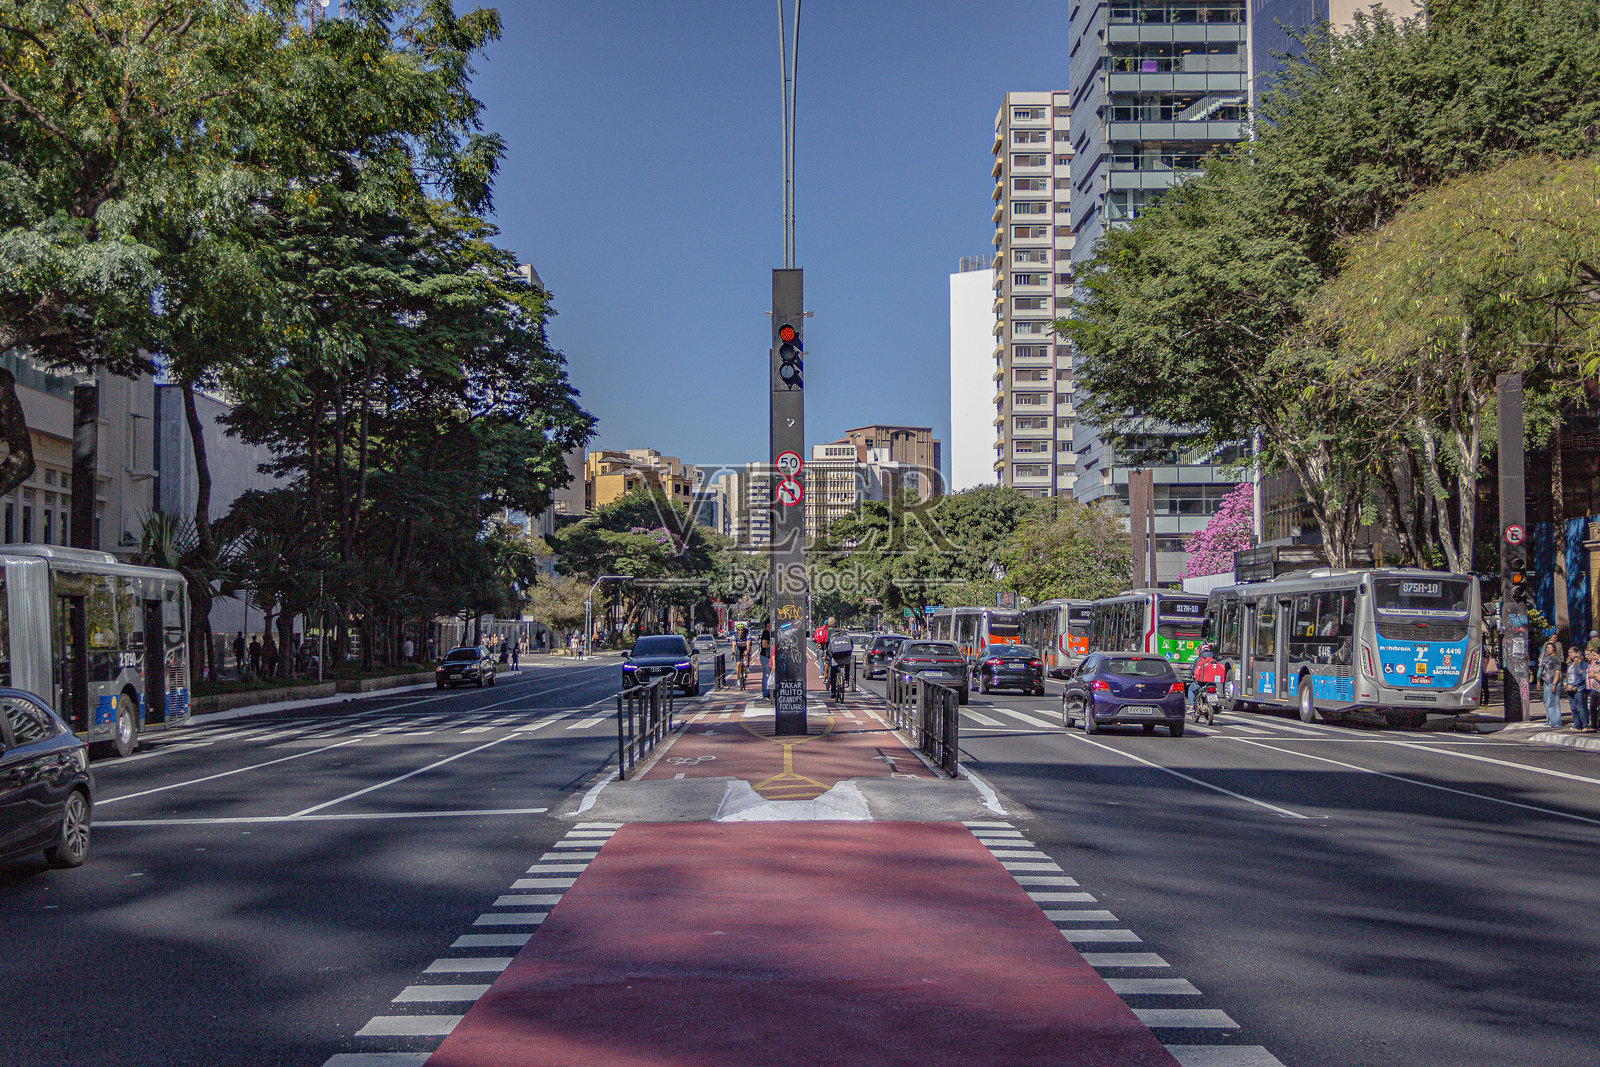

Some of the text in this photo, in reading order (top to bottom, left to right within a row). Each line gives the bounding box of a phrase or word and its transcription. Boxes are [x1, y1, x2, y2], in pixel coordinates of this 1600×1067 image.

[780, 457, 798, 469] 50
[1403, 582, 1438, 593] 875A-10
[778, 695, 803, 703] GRANDES
